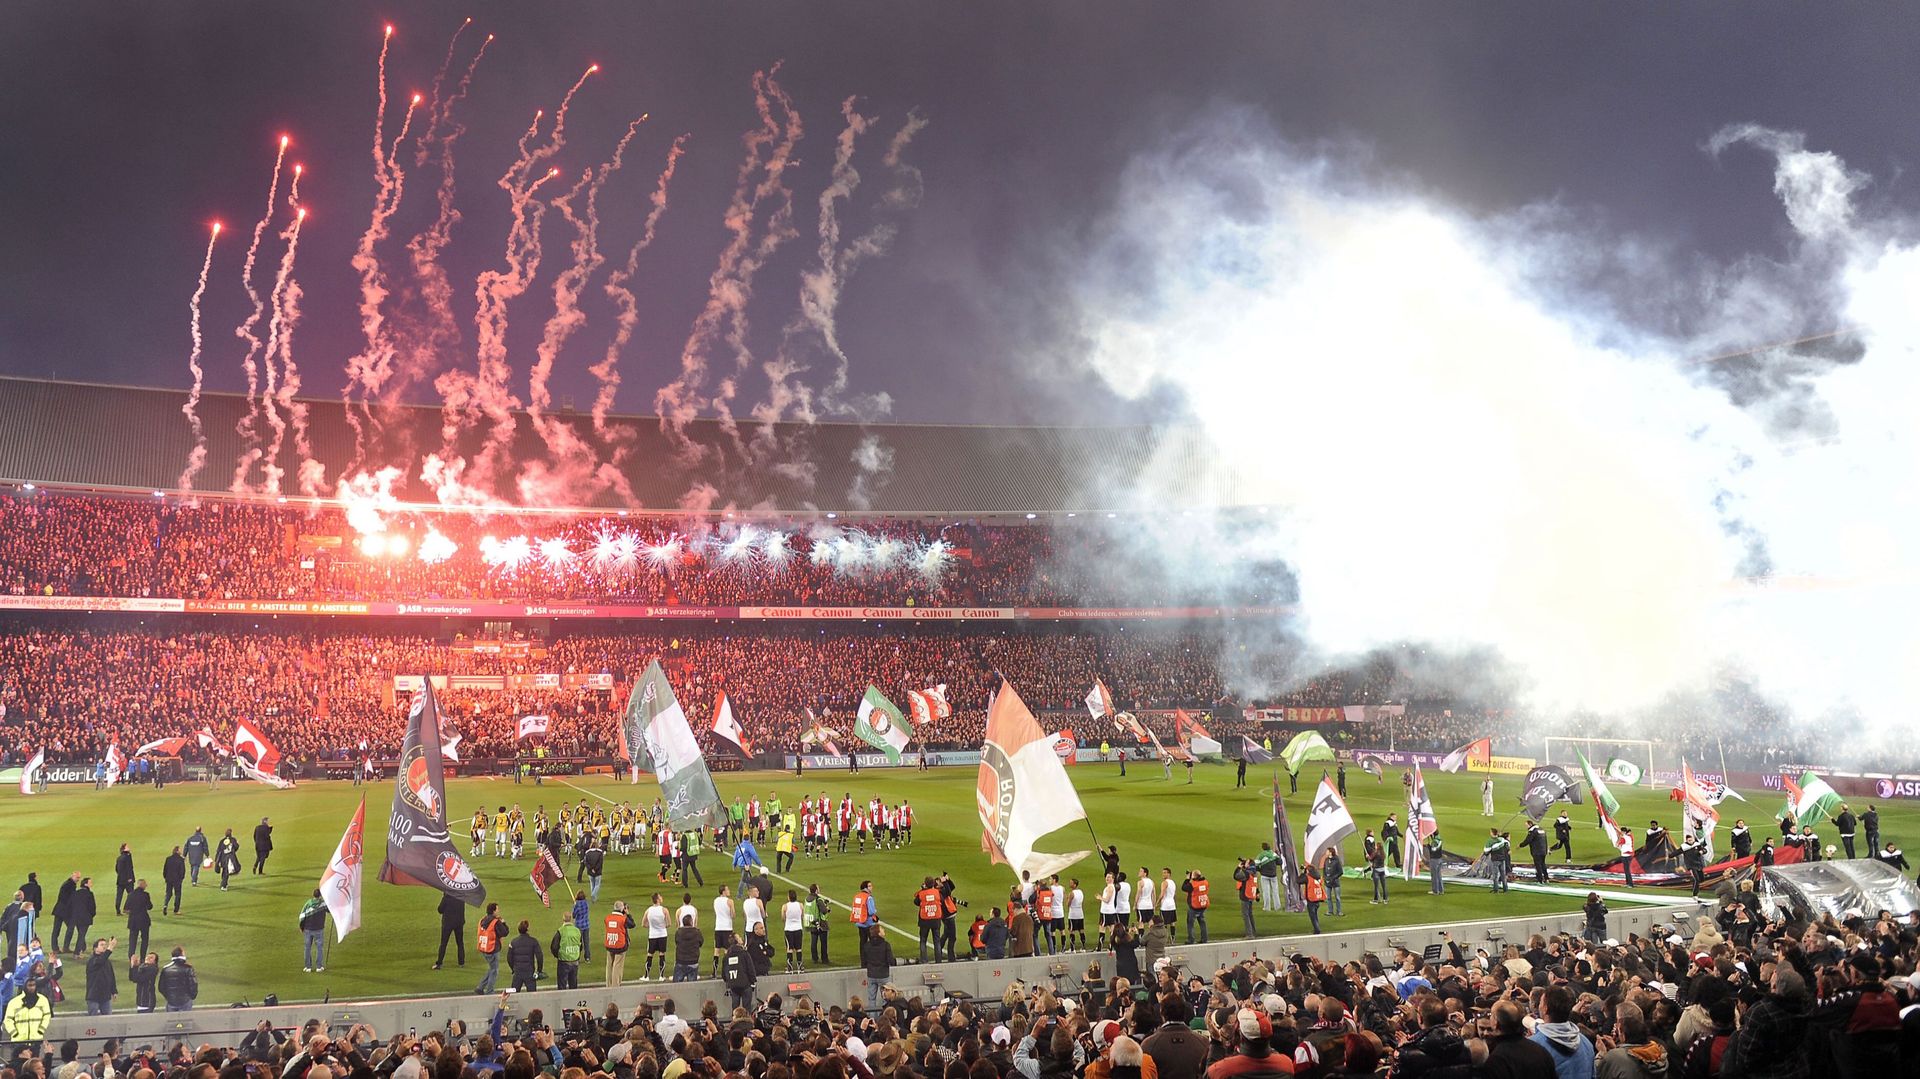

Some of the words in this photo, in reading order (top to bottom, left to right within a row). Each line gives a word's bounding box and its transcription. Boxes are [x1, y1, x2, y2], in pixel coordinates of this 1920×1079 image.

[196, 601, 225, 610] AMSTEL
[227, 602, 246, 611] BIER
[258, 603, 289, 611] AMSTEL
[290, 603, 307, 611] BIER
[319, 604, 347, 612] AMSTEL
[348, 604, 367, 612] BIER
[423, 605, 472, 614] verzekeringen
[532, 606, 547, 614] ASR
[549, 606, 595, 615] verzekeringen
[669, 607, 715, 616] verzekeringen
[761, 608, 802, 617] Canon
[812, 608, 852, 617] Canon
[862, 608, 902, 617] Canon
[912, 608, 952, 618] Canon
[961, 608, 1000, 618] Canon
[1762, 774, 1782, 791] Wij
[728, 969, 738, 980] TV
[577, 1000, 587, 1008] 42
[422, 1010, 432, 1018] 43
[85, 1028, 97, 1036] 45
